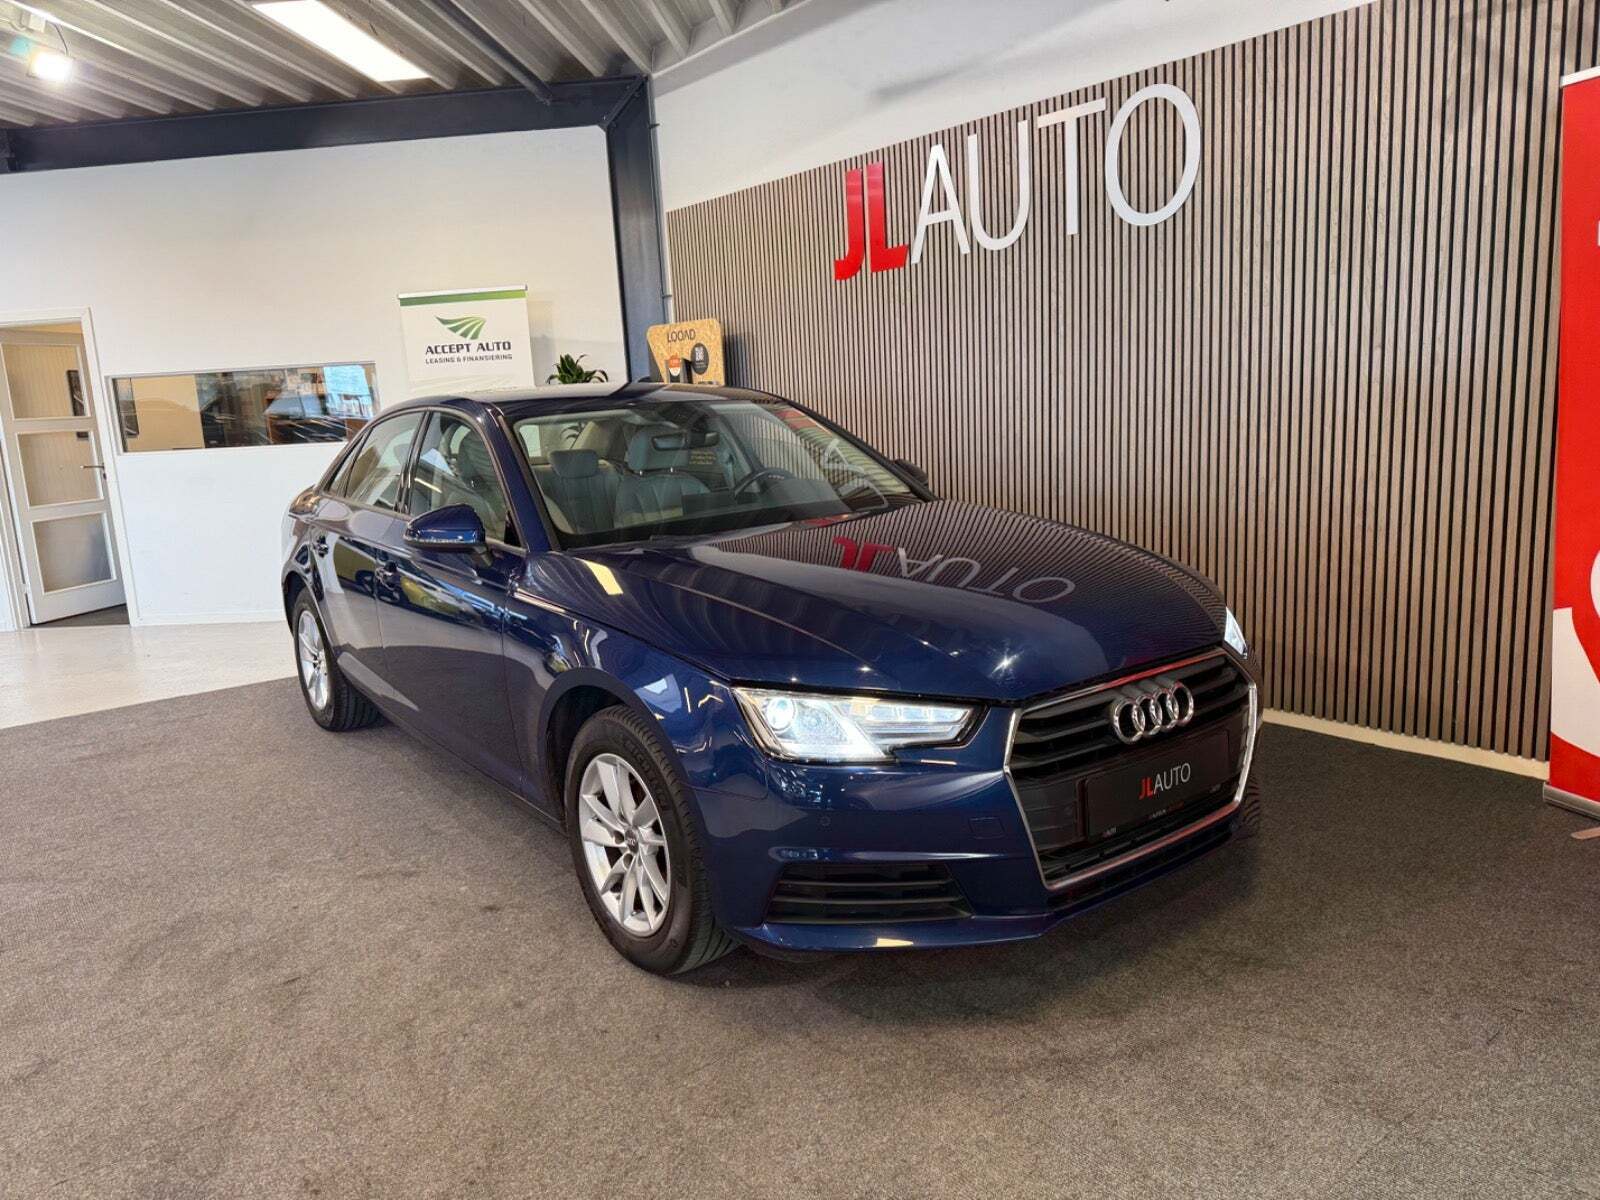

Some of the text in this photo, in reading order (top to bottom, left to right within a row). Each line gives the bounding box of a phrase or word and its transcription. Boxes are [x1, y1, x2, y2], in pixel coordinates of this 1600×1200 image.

[425, 341, 512, 356] ACCEPT AUTO
[425, 356, 456, 364] LEASING
[462, 354, 513, 363] FINANSIERING
